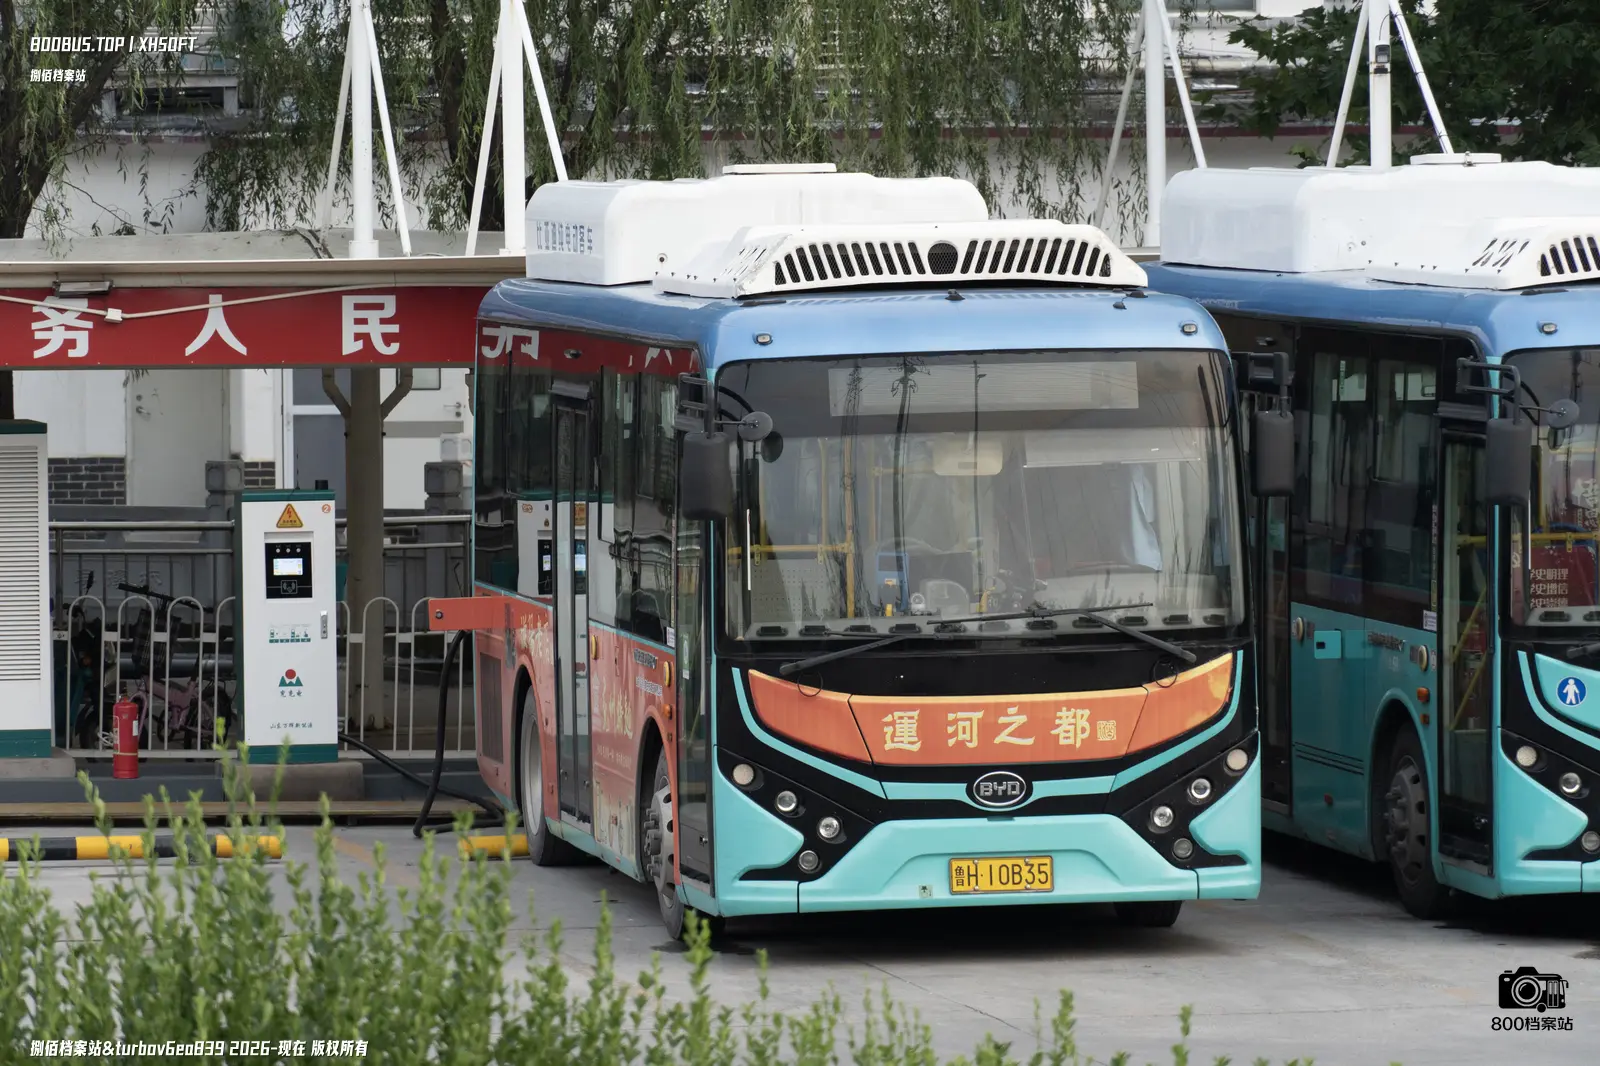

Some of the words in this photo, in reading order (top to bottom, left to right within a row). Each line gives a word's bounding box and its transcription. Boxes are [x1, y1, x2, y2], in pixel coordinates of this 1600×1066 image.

[881, 704, 1092, 752] 運河之都
[979, 781, 1020, 797] BYD
